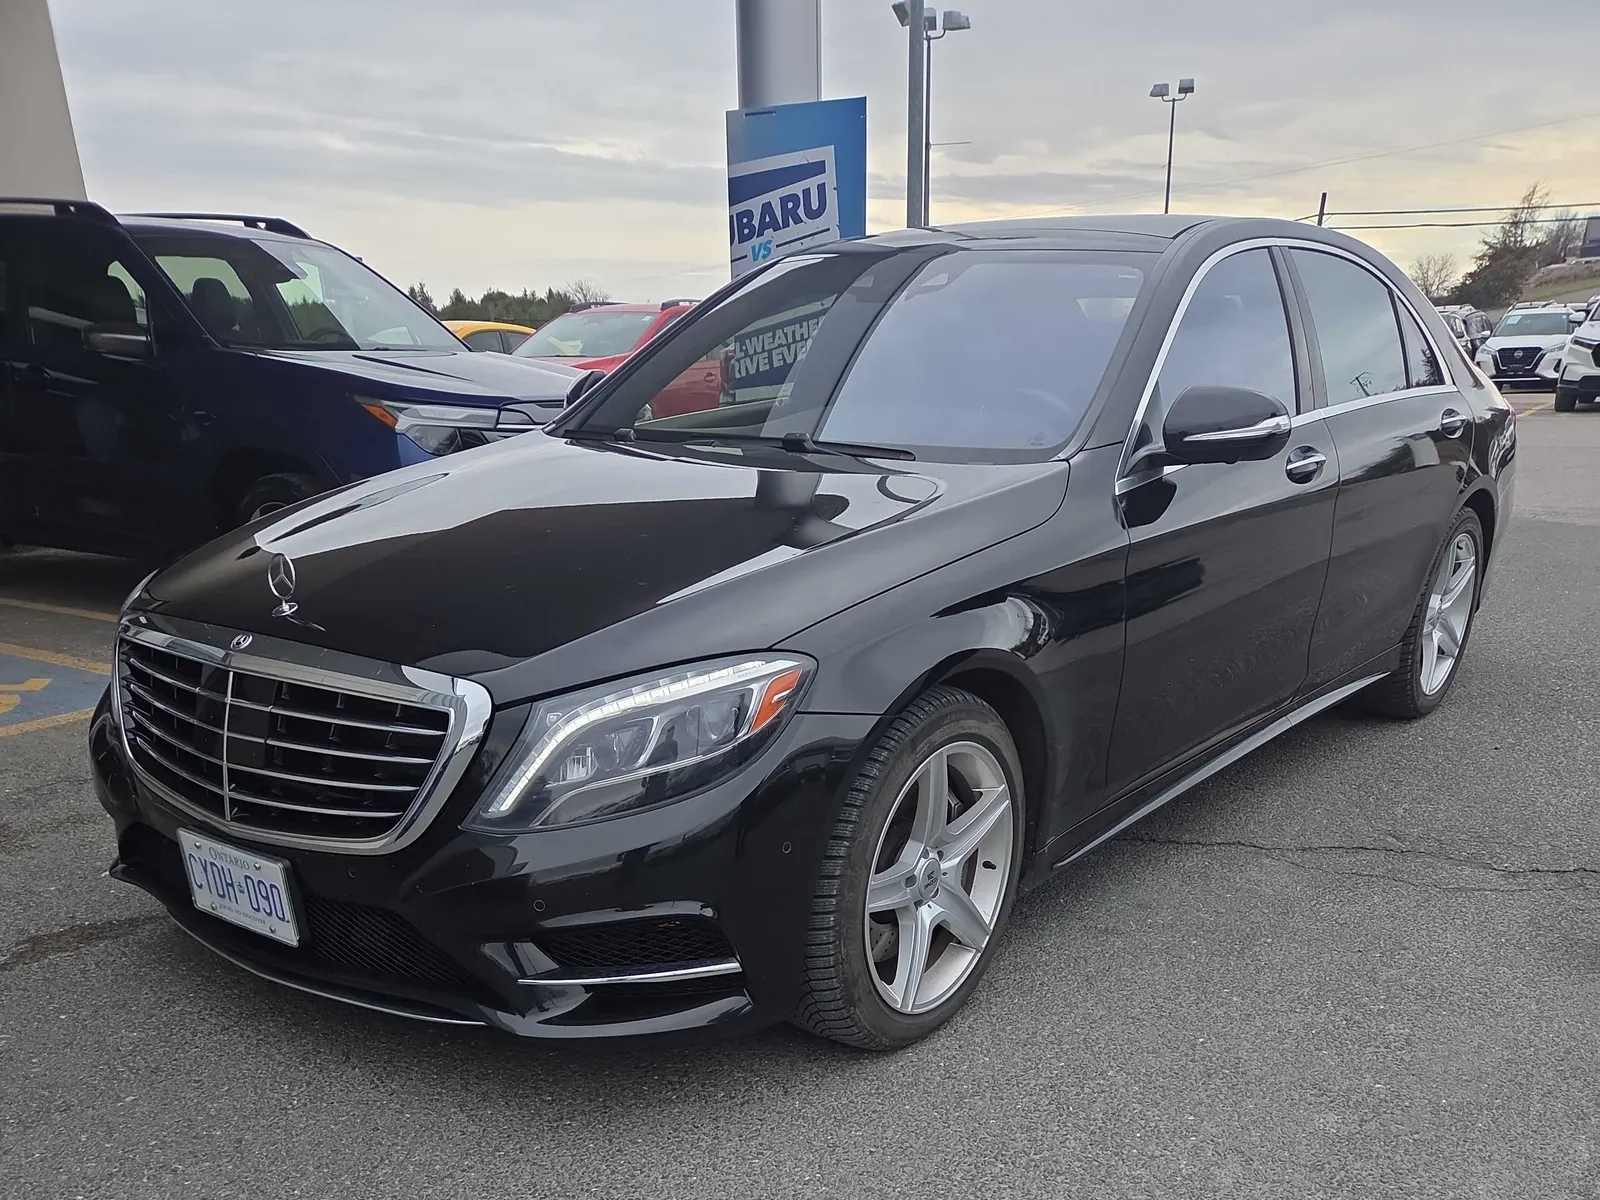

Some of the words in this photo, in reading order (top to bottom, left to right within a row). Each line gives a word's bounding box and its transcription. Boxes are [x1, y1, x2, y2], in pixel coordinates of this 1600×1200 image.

[730, 181, 828, 246] BARU
[751, 237, 773, 262] VS
[735, 315, 826, 358] L-WEATHE
[772, 338, 813, 368] EVE
[208, 846, 250, 871] ONTARIO
